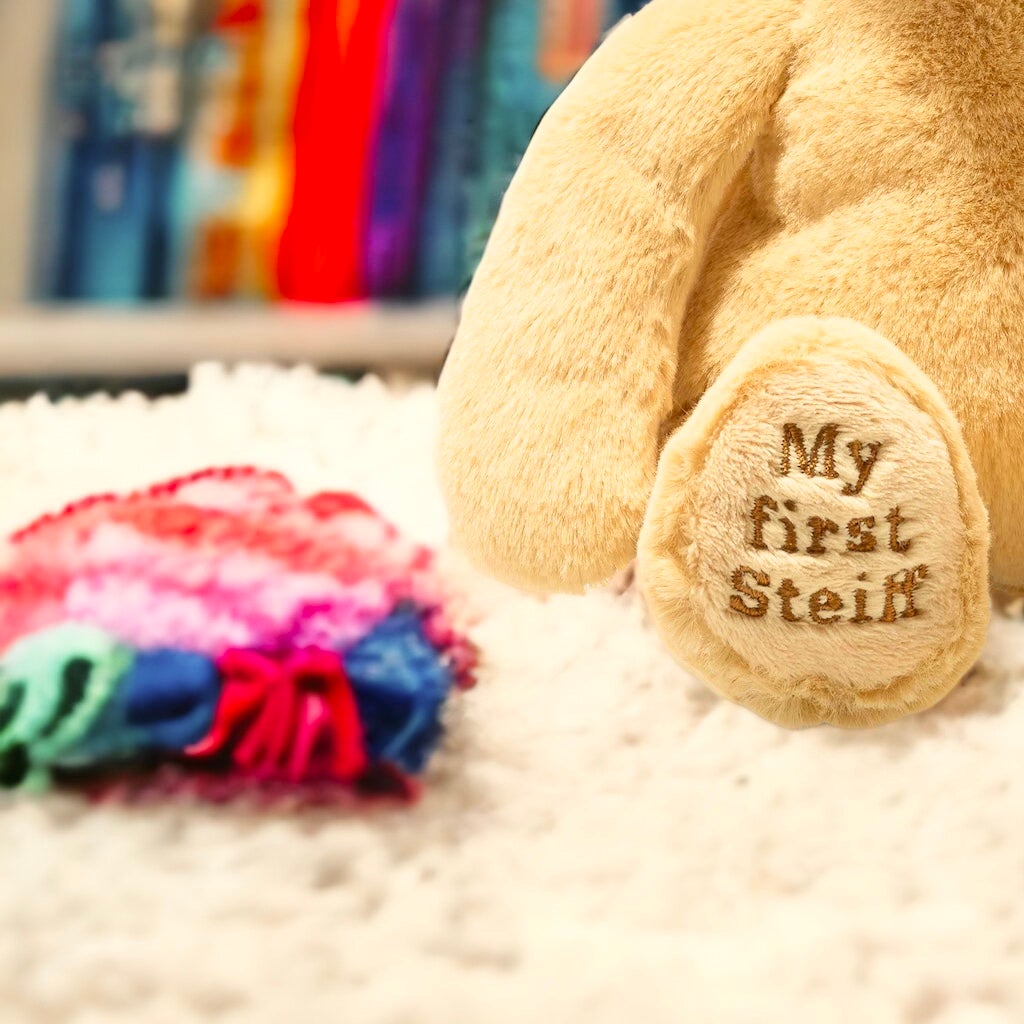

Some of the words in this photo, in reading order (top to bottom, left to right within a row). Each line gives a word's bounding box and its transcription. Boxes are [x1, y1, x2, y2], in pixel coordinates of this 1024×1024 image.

[780, 422, 883, 495] My
[750, 494, 911, 554] first
[729, 563, 929, 625] Steiff
